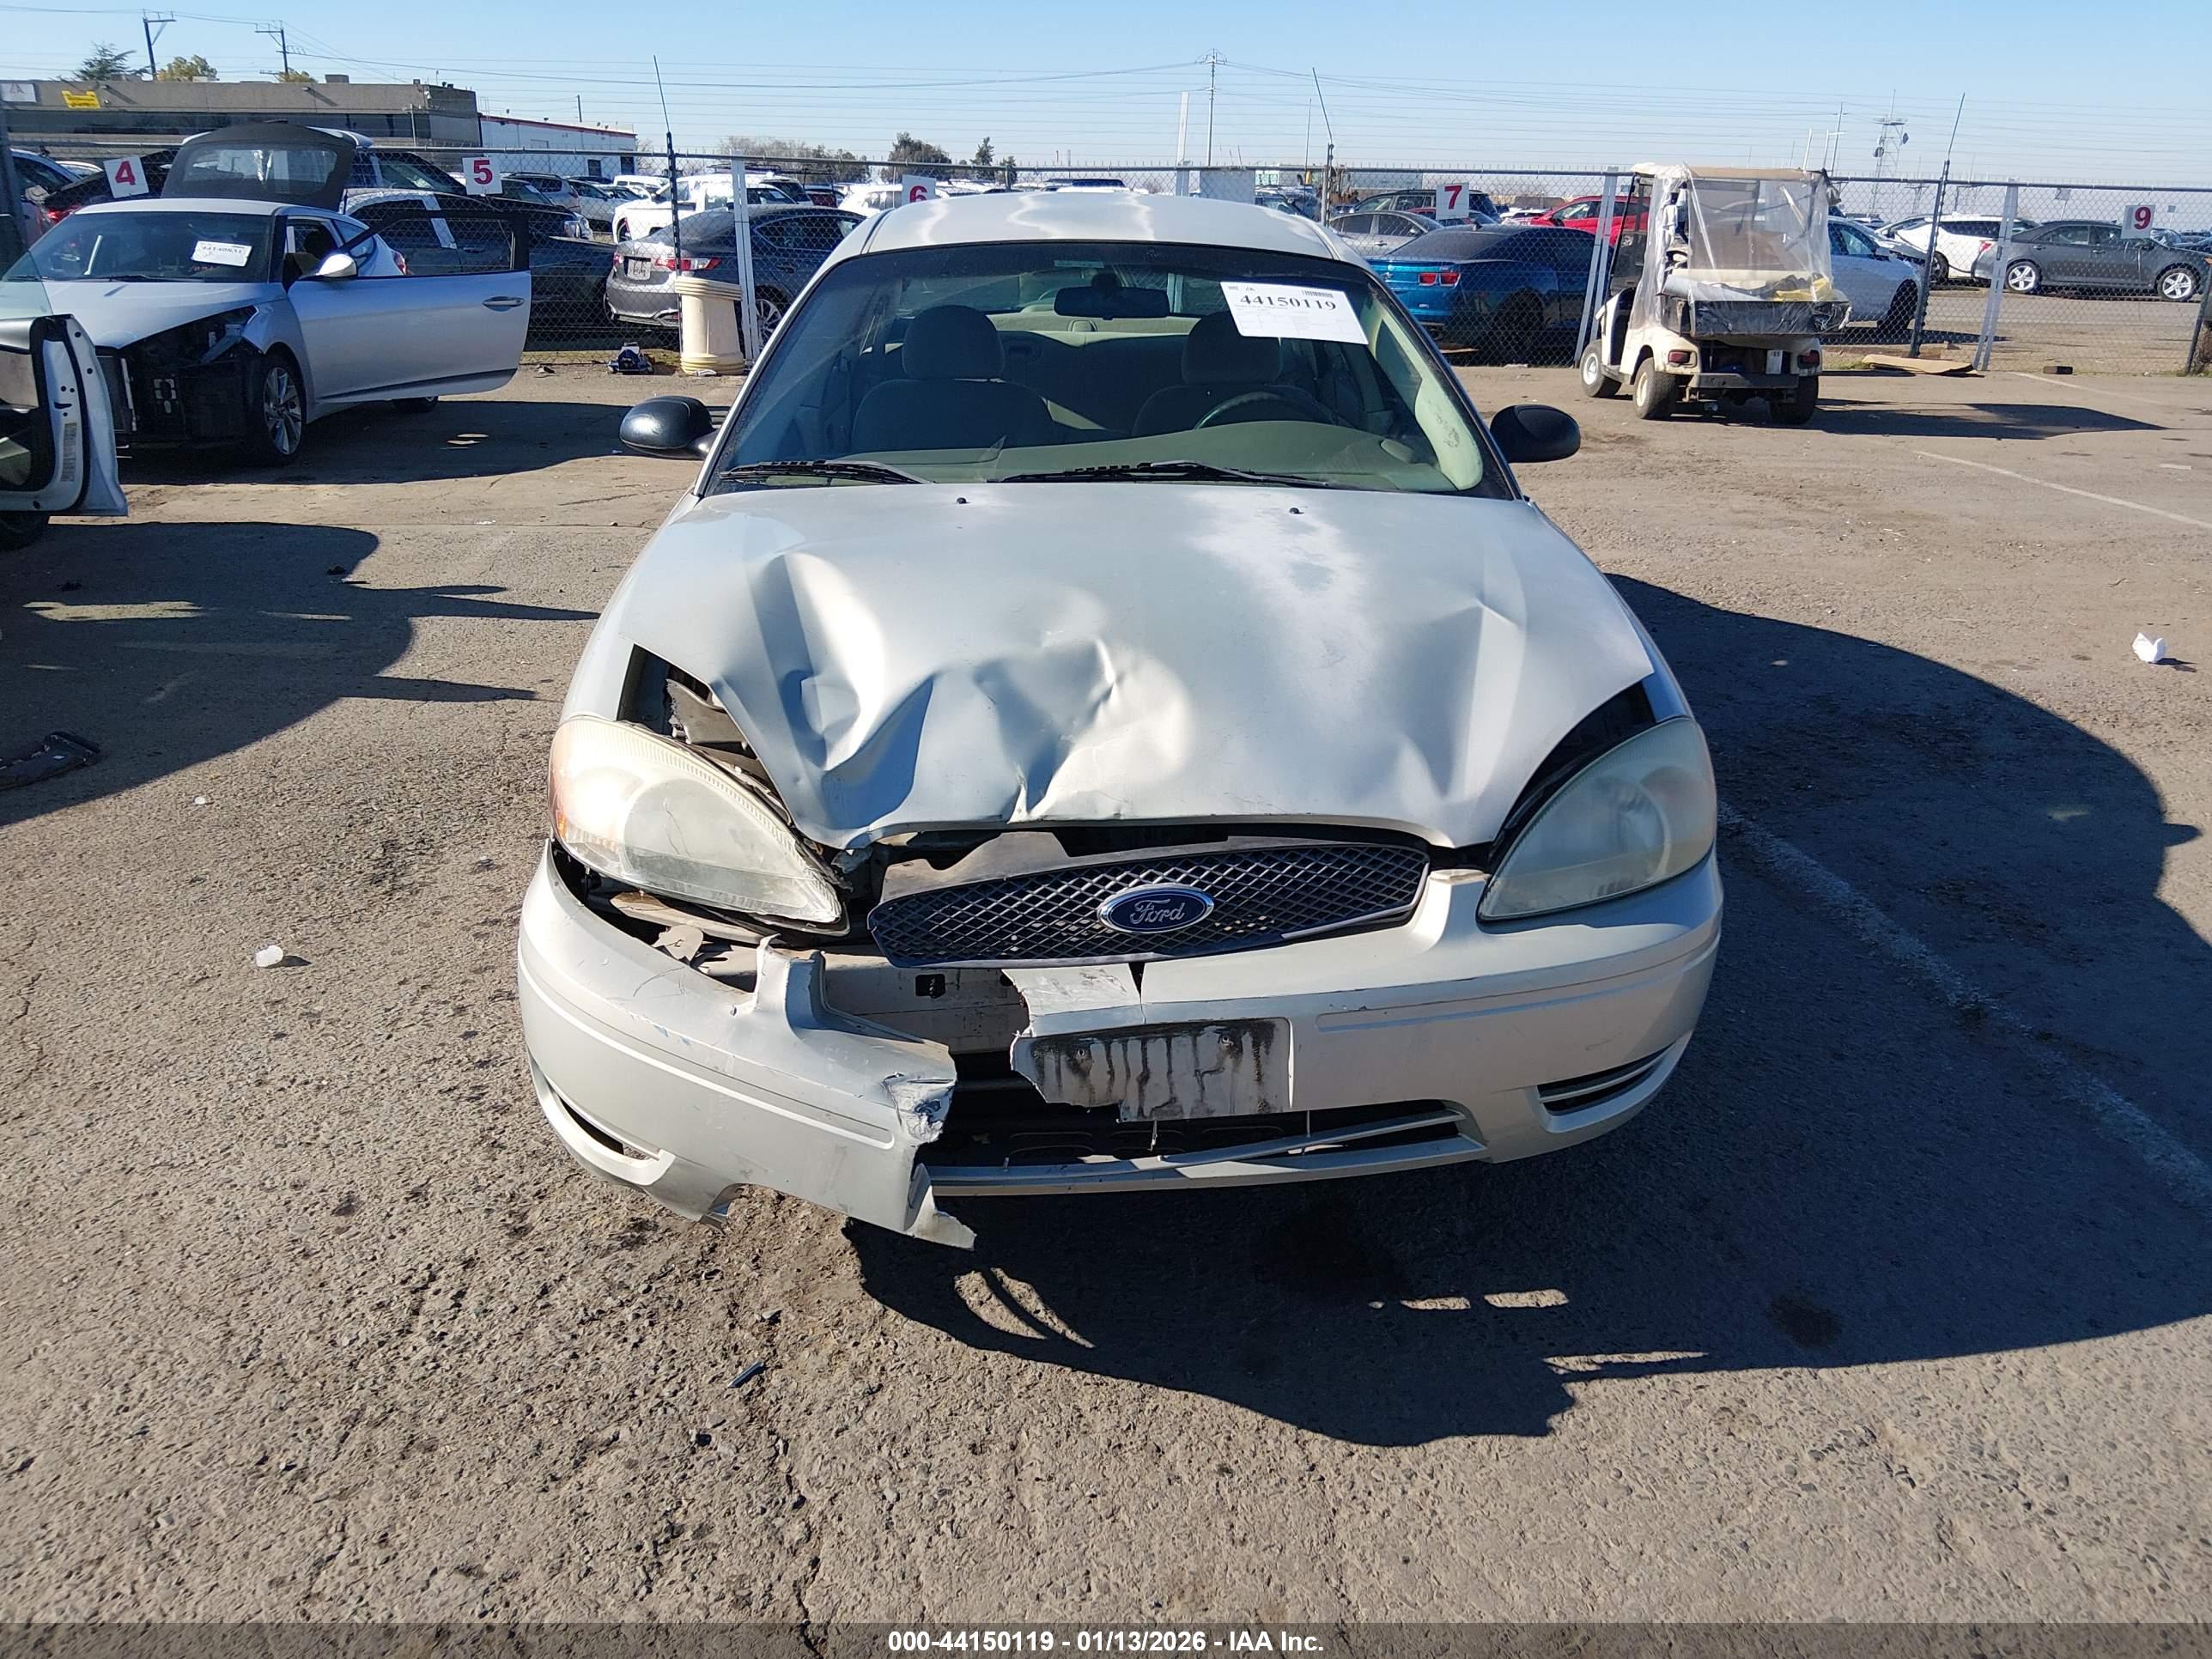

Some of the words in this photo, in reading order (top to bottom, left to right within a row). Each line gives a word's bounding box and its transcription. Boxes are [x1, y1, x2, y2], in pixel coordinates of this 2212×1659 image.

[115, 161, 136, 185] 4
[473, 160, 493, 185] 5
[909, 185, 927, 204] 6
[1444, 185, 1462, 210] 7
[1239, 295, 1338, 311] 44150119
[1129, 898, 1186, 925] Ford
